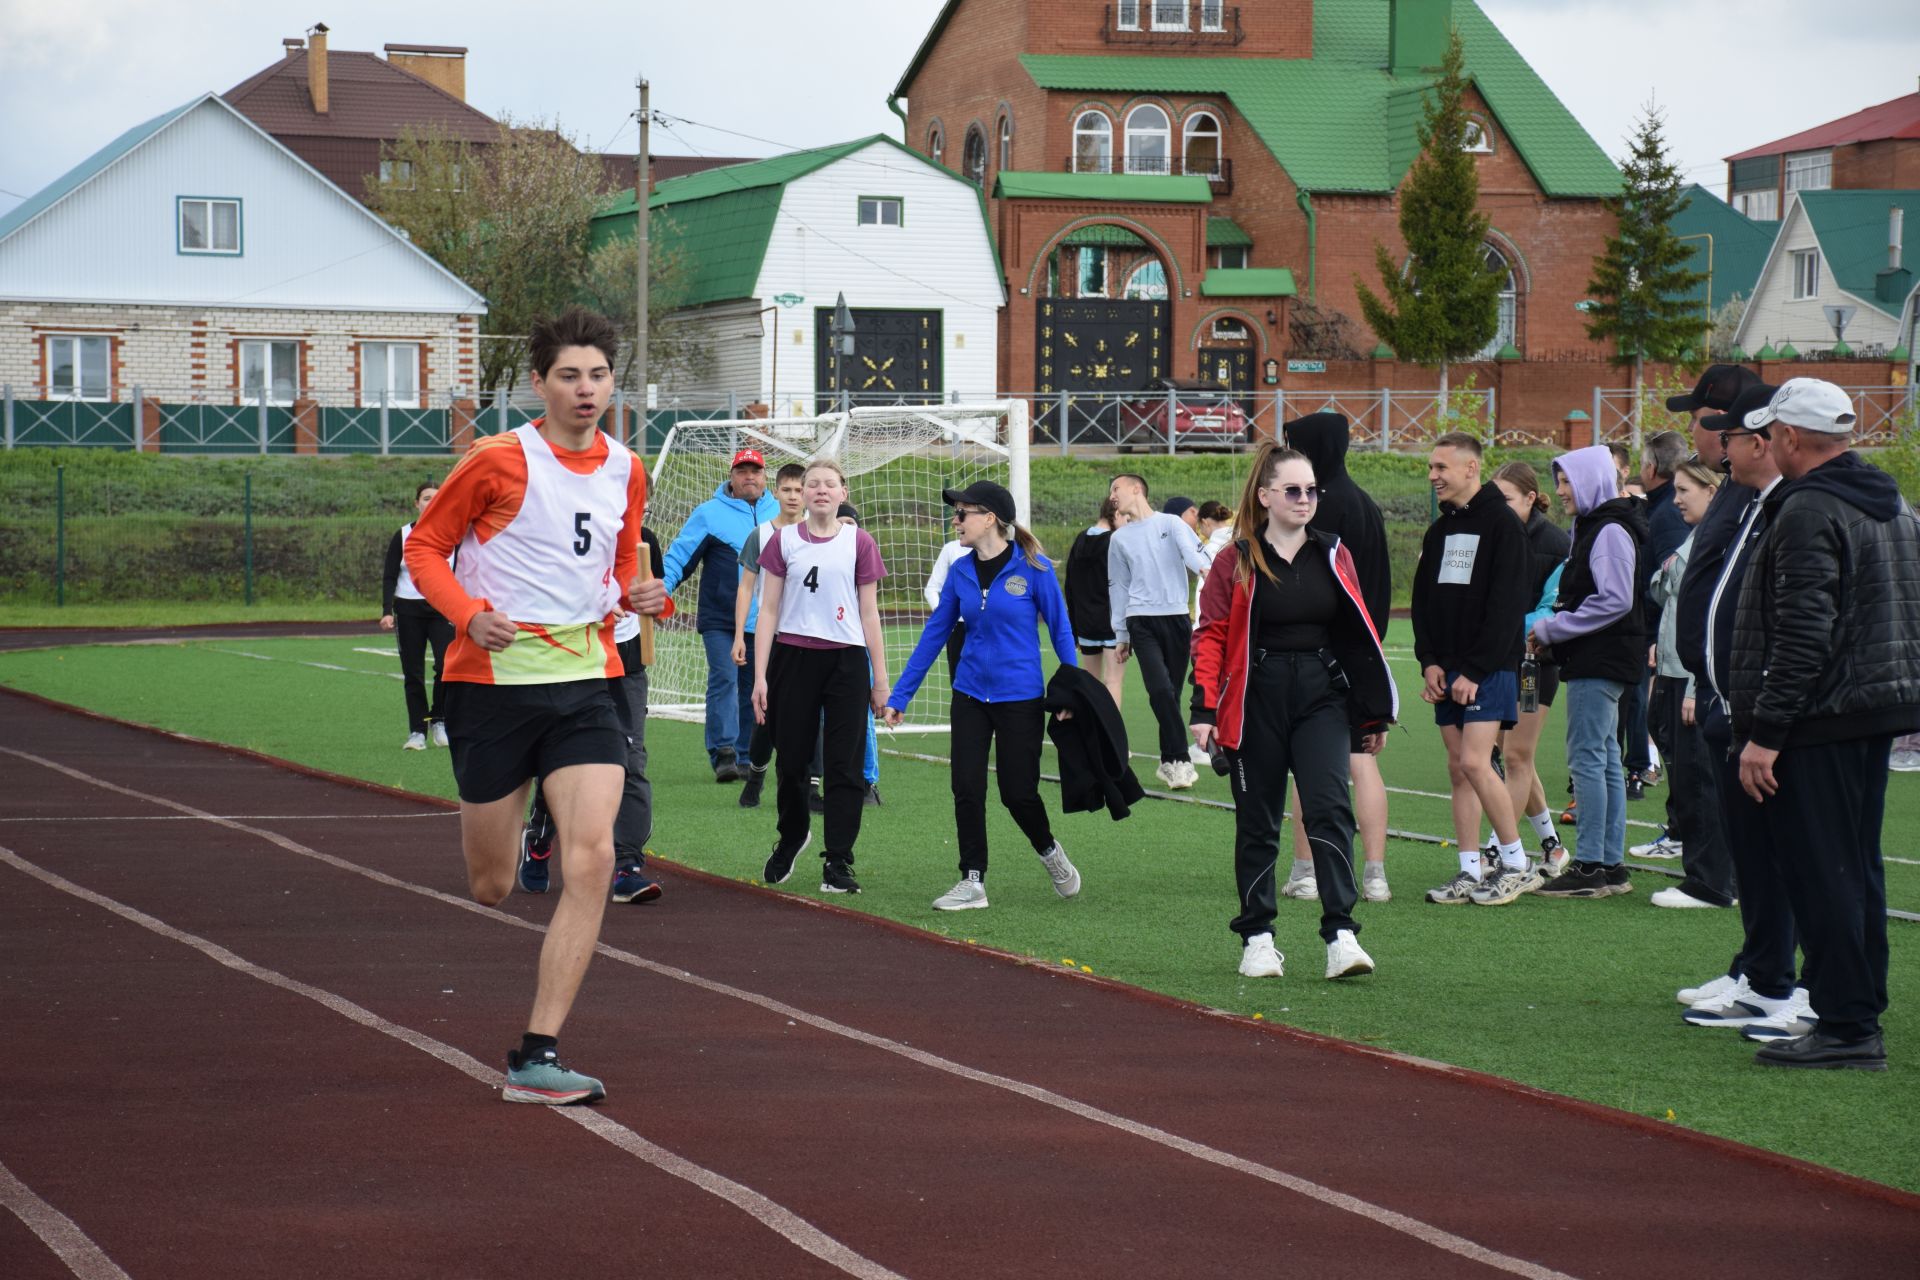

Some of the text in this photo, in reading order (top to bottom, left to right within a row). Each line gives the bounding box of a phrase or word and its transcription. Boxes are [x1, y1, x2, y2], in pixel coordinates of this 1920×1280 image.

[573, 512, 592, 557] 5
[602, 566, 612, 589] 4
[802, 565, 819, 594] 4
[836, 606, 845, 621] 3
